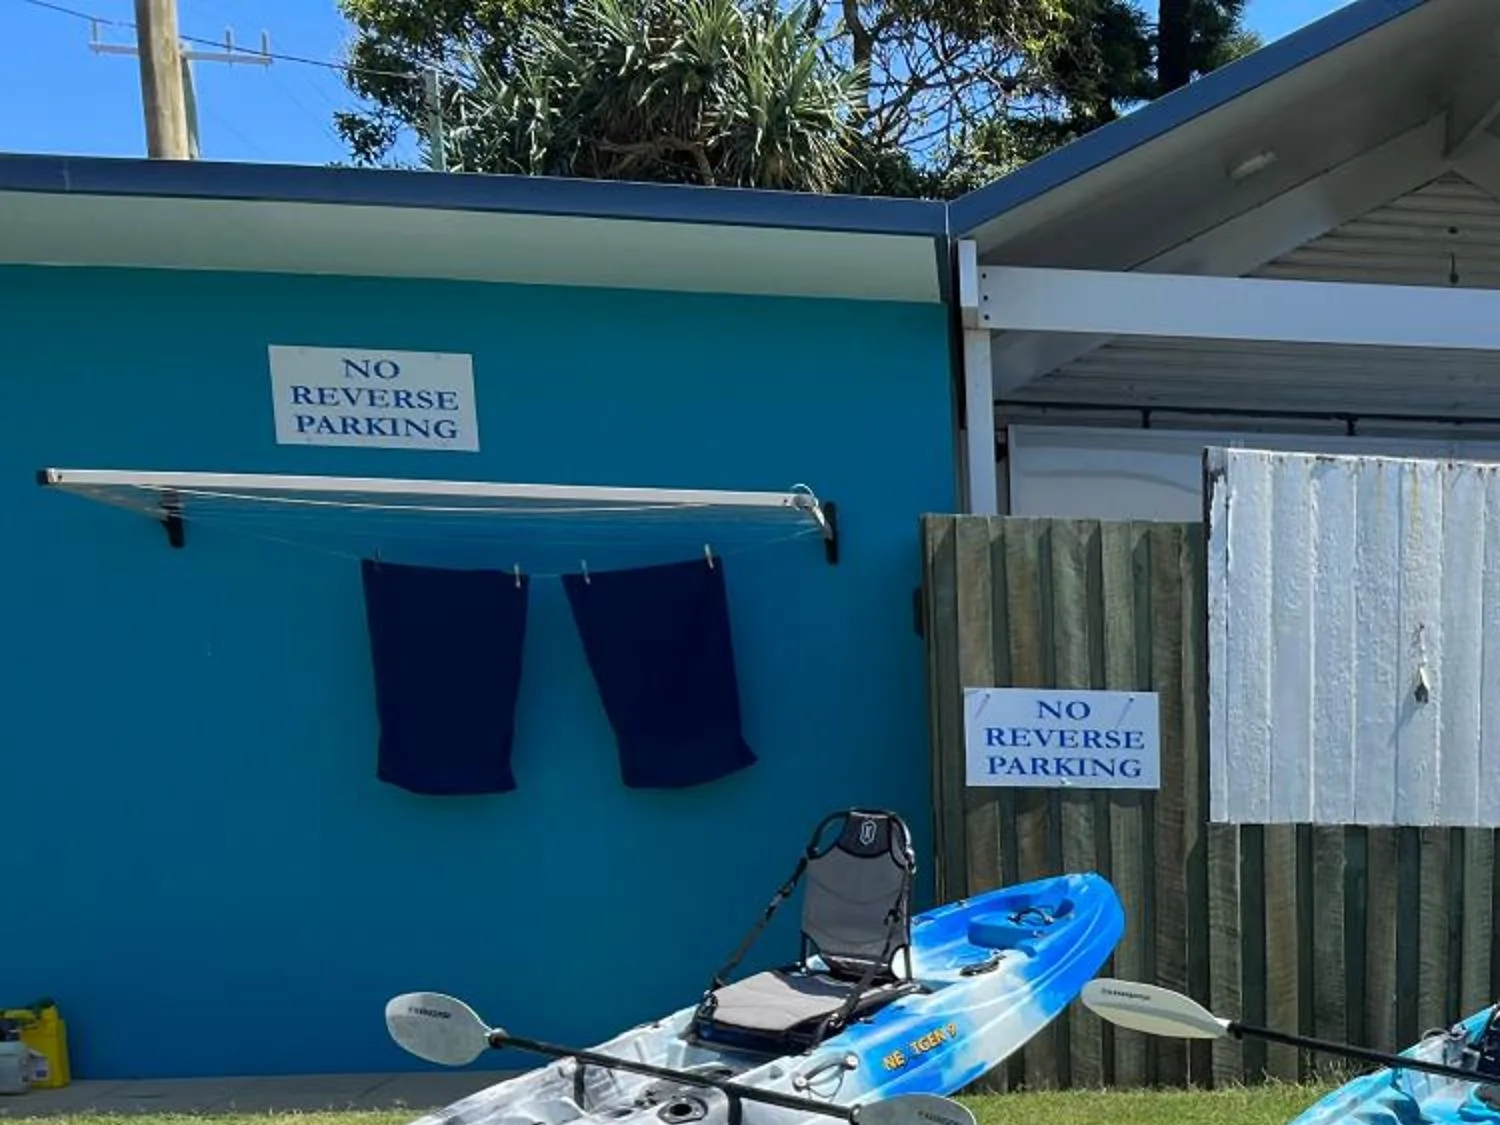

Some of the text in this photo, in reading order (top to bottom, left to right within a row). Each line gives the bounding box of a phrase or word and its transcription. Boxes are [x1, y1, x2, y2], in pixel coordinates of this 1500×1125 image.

[342, 359, 400, 379] NO
[290, 386, 459, 411] REVERSE
[296, 415, 458, 439] PARKING
[1038, 700, 1091, 721] NO
[985, 728, 1145, 750] REVERSE
[988, 755, 1142, 779] PARKING
